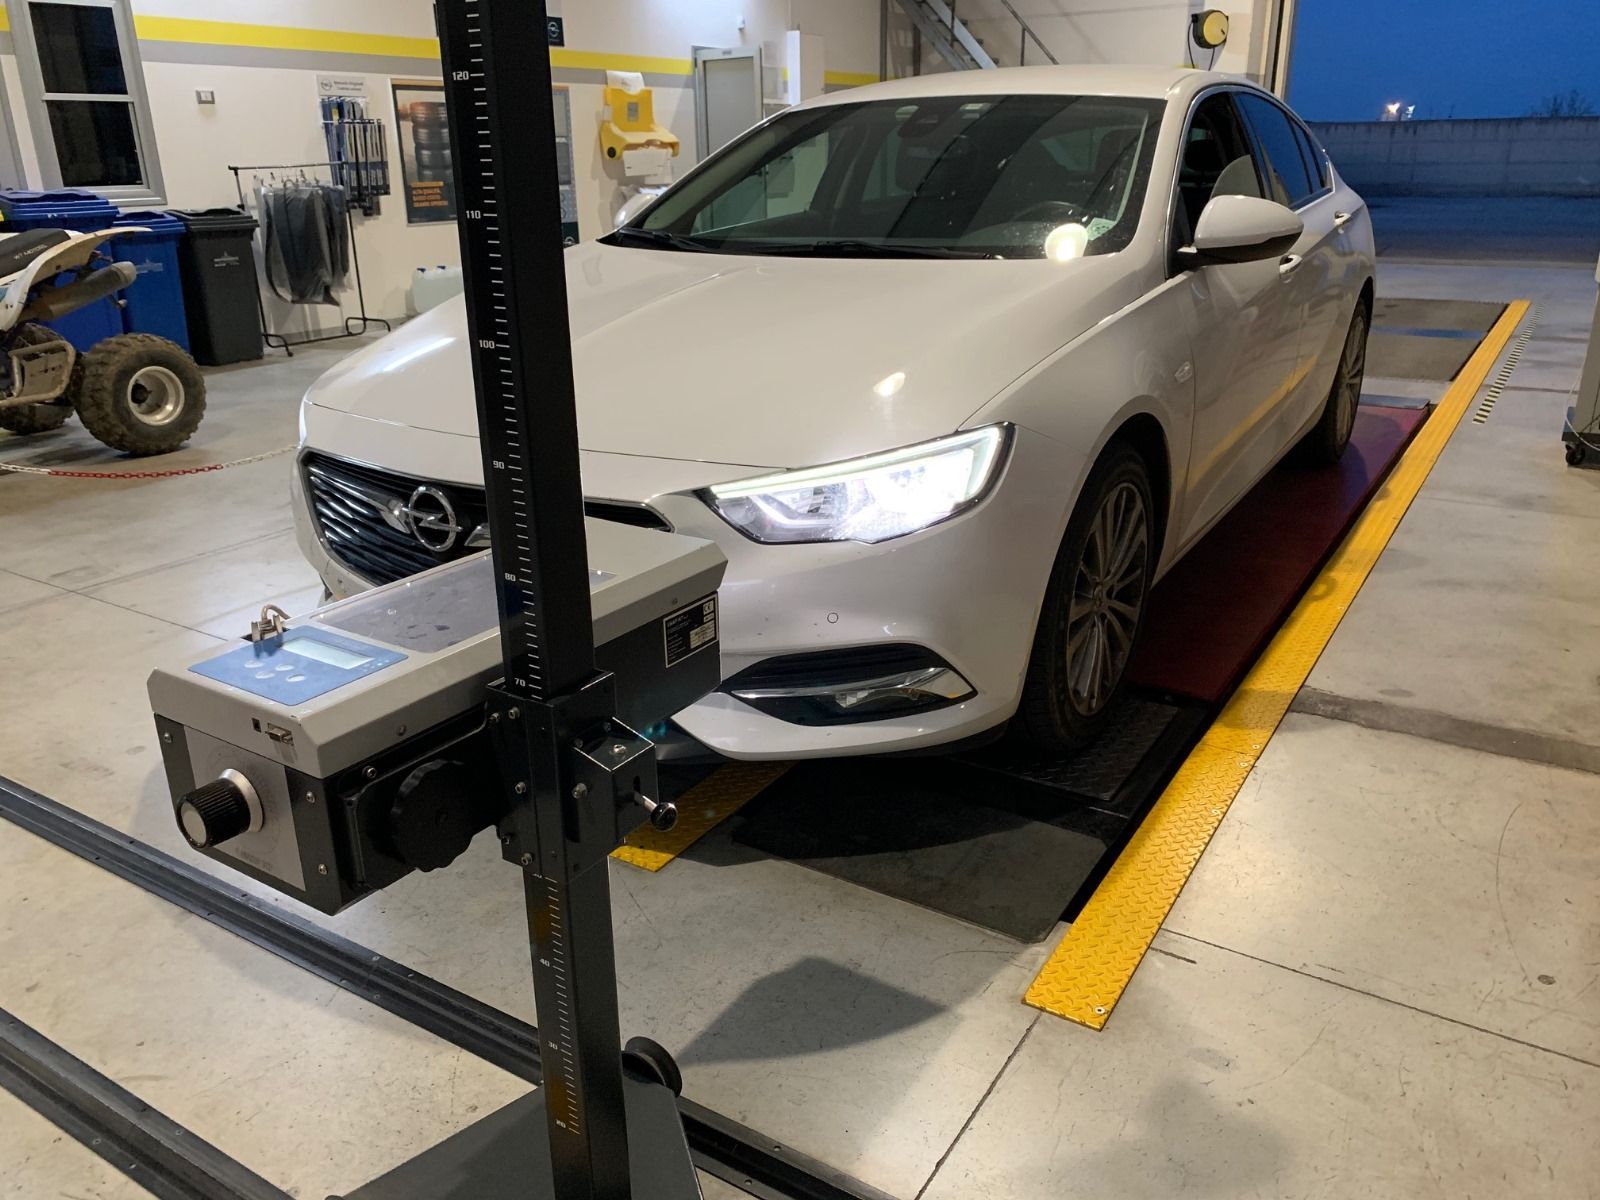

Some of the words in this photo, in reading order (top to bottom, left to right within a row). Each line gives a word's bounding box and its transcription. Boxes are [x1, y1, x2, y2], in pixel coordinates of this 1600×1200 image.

[452, 71, 469, 80] 120
[466, 210, 481, 219] 110
[479, 339, 495, 349] 100
[493, 460, 504, 469] 90
[505, 572, 516, 581] 80
[514, 677, 526, 687] 70
[540, 958, 550, 967] 40
